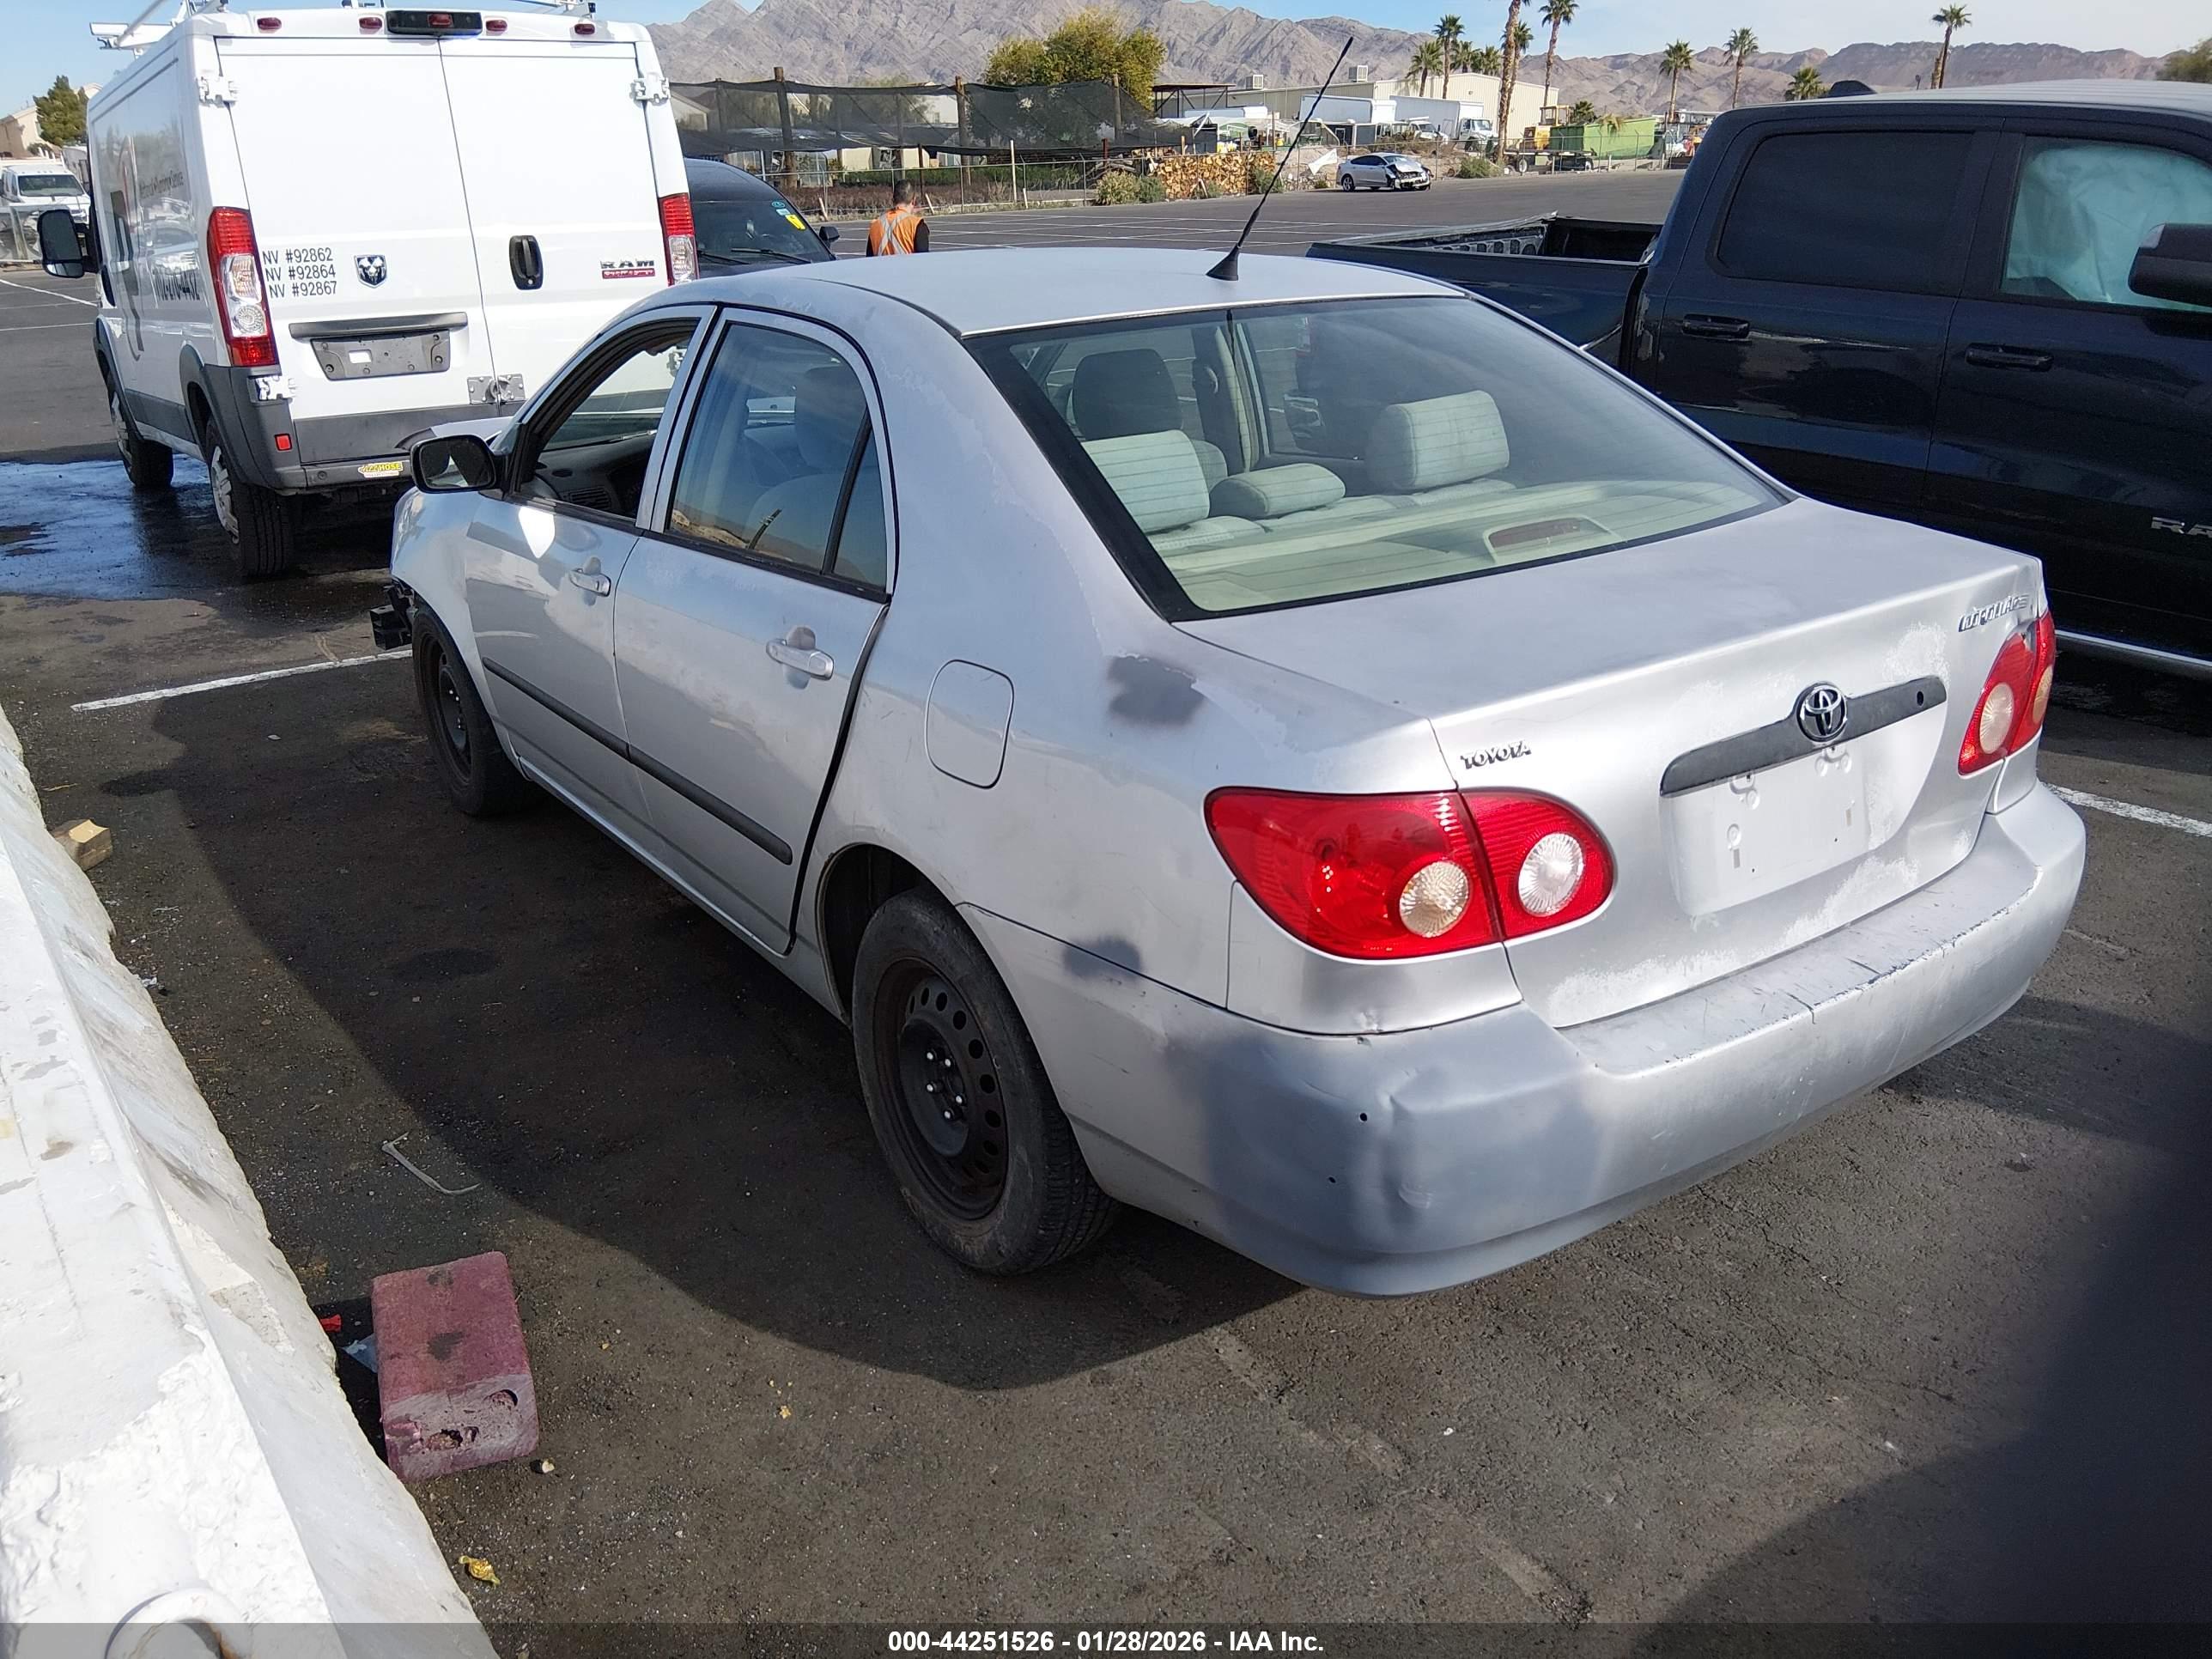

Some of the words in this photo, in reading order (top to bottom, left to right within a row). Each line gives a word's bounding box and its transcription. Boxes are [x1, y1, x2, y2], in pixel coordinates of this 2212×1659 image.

[262, 250, 279, 264] NV
[285, 246, 334, 263] #92862
[600, 259, 654, 269] RAM
[265, 267, 282, 282] NV
[288, 264, 337, 280] #92864
[269, 283, 285, 298] NV
[291, 280, 337, 296] #92867
[1460, 740, 1532, 769] TOYOTA
